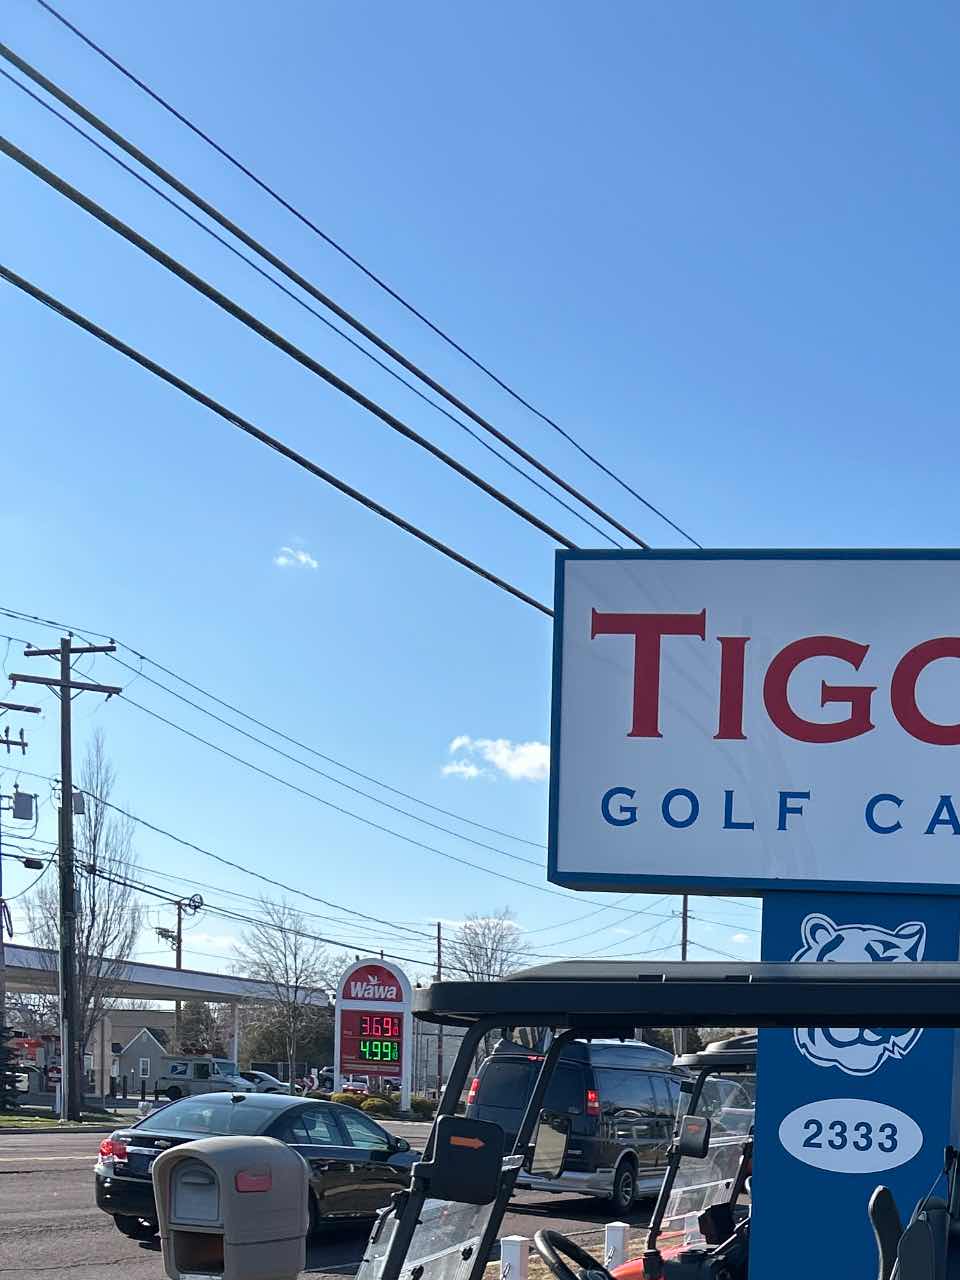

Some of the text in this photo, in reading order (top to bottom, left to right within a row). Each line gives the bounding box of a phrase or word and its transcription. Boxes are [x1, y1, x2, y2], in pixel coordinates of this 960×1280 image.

[601, 786, 811, 831] GOLF
[350, 981, 397, 999] Wawa
[360, 1040, 391, 1060] 4.99
[802, 1118, 898, 1153] 2333
